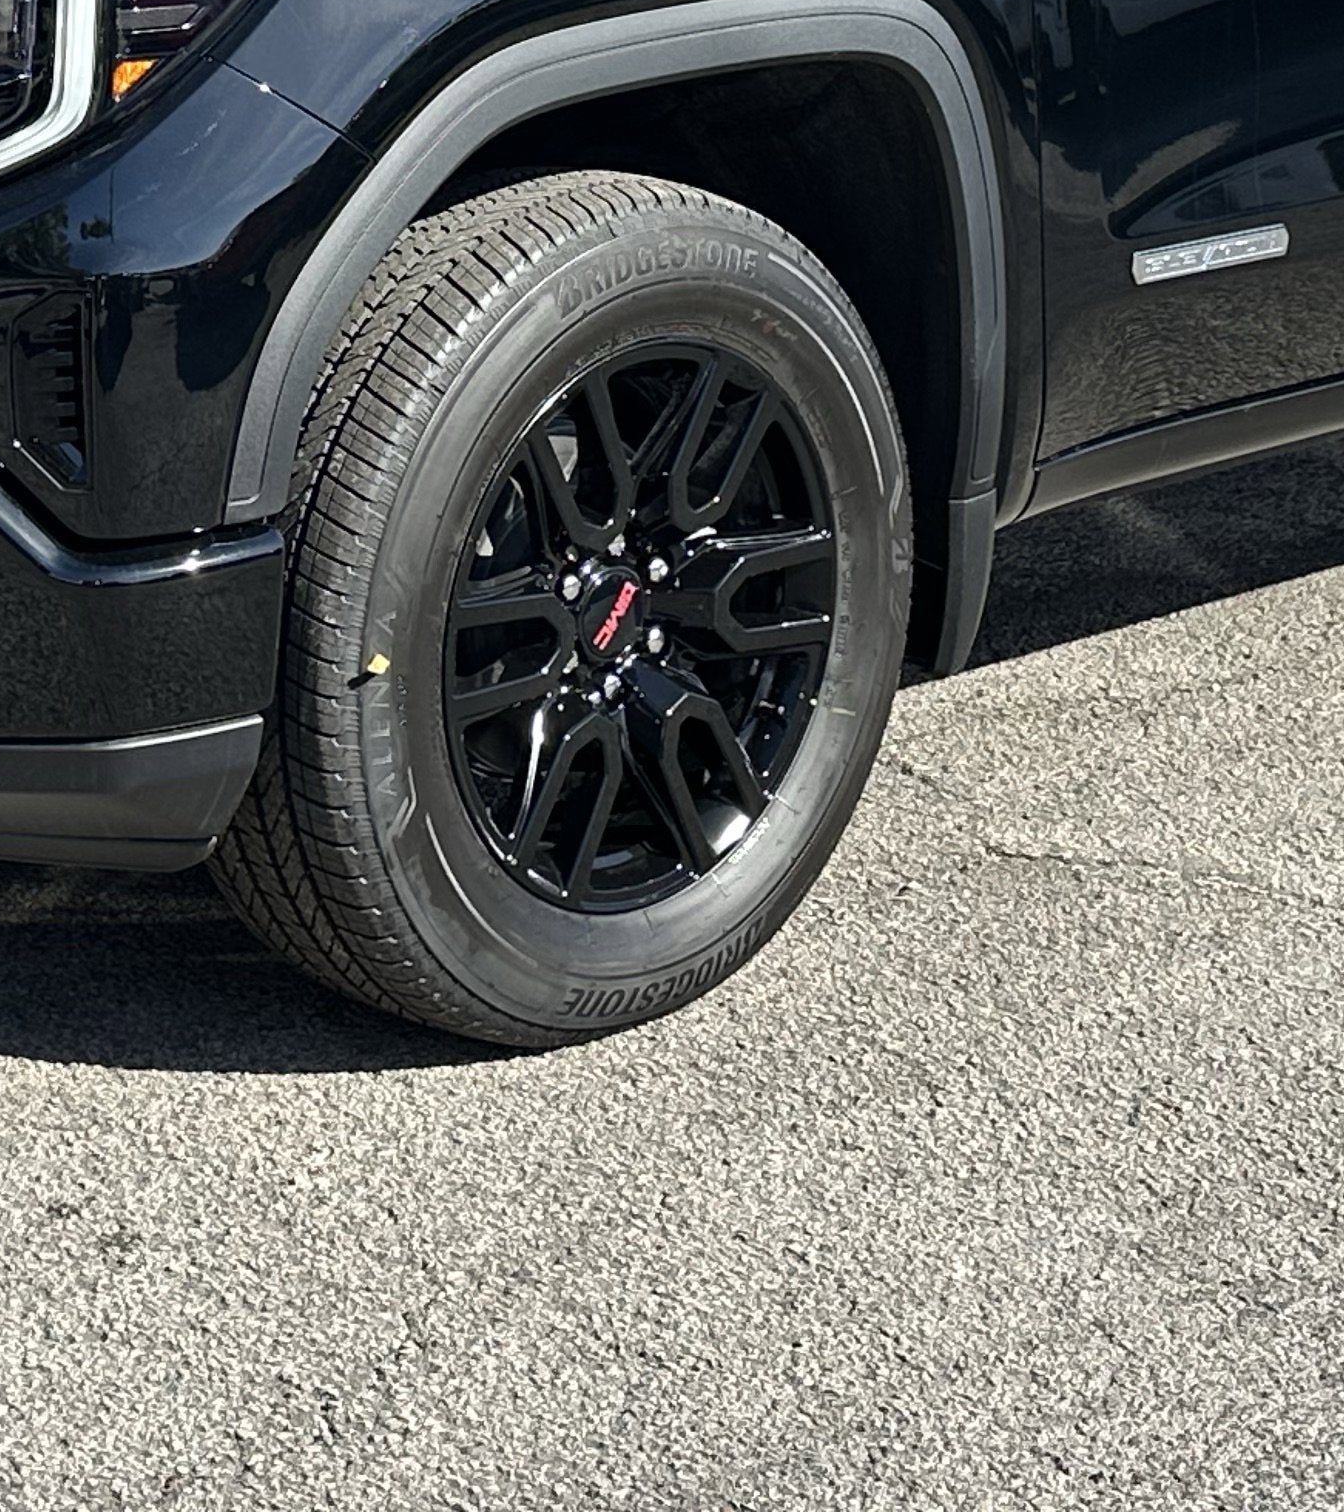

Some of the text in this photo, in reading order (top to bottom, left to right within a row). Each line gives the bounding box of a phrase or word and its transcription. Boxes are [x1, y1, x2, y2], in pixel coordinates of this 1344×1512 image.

[558, 239, 759, 320] BRIDGESTONE
[593, 581, 639, 650] GMC
[557, 915, 764, 1018] BRIDGESTONE
